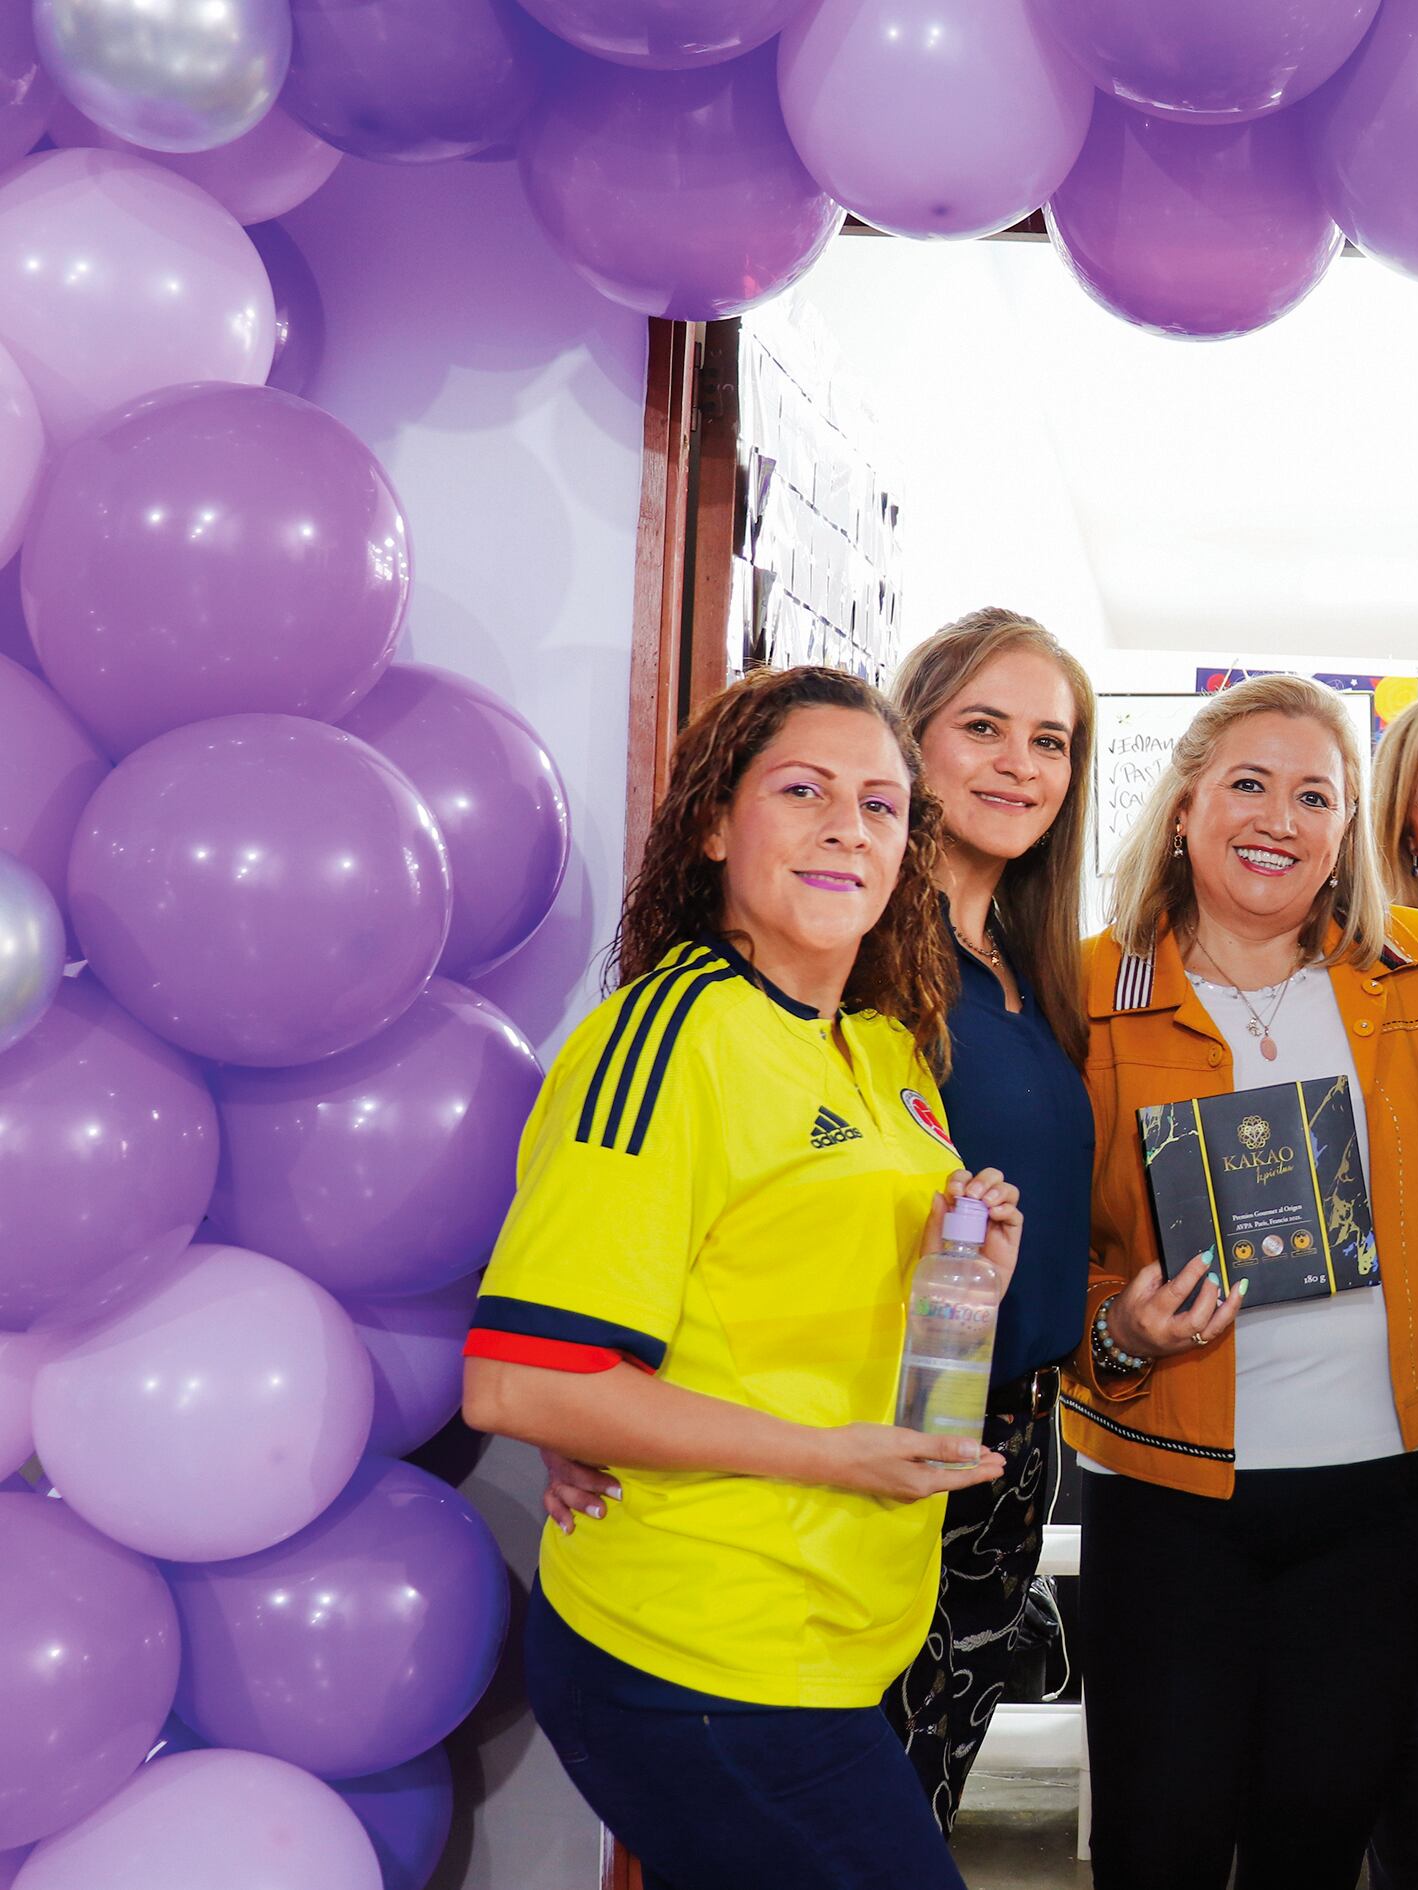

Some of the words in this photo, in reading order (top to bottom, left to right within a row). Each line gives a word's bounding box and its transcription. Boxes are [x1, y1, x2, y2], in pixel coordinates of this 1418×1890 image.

[811, 1127, 863, 1148] adidas
[1222, 1146, 1294, 1172] KAKAO
[1303, 1275, 1318, 1284] 180
[1320, 1274, 1327, 1283] g
